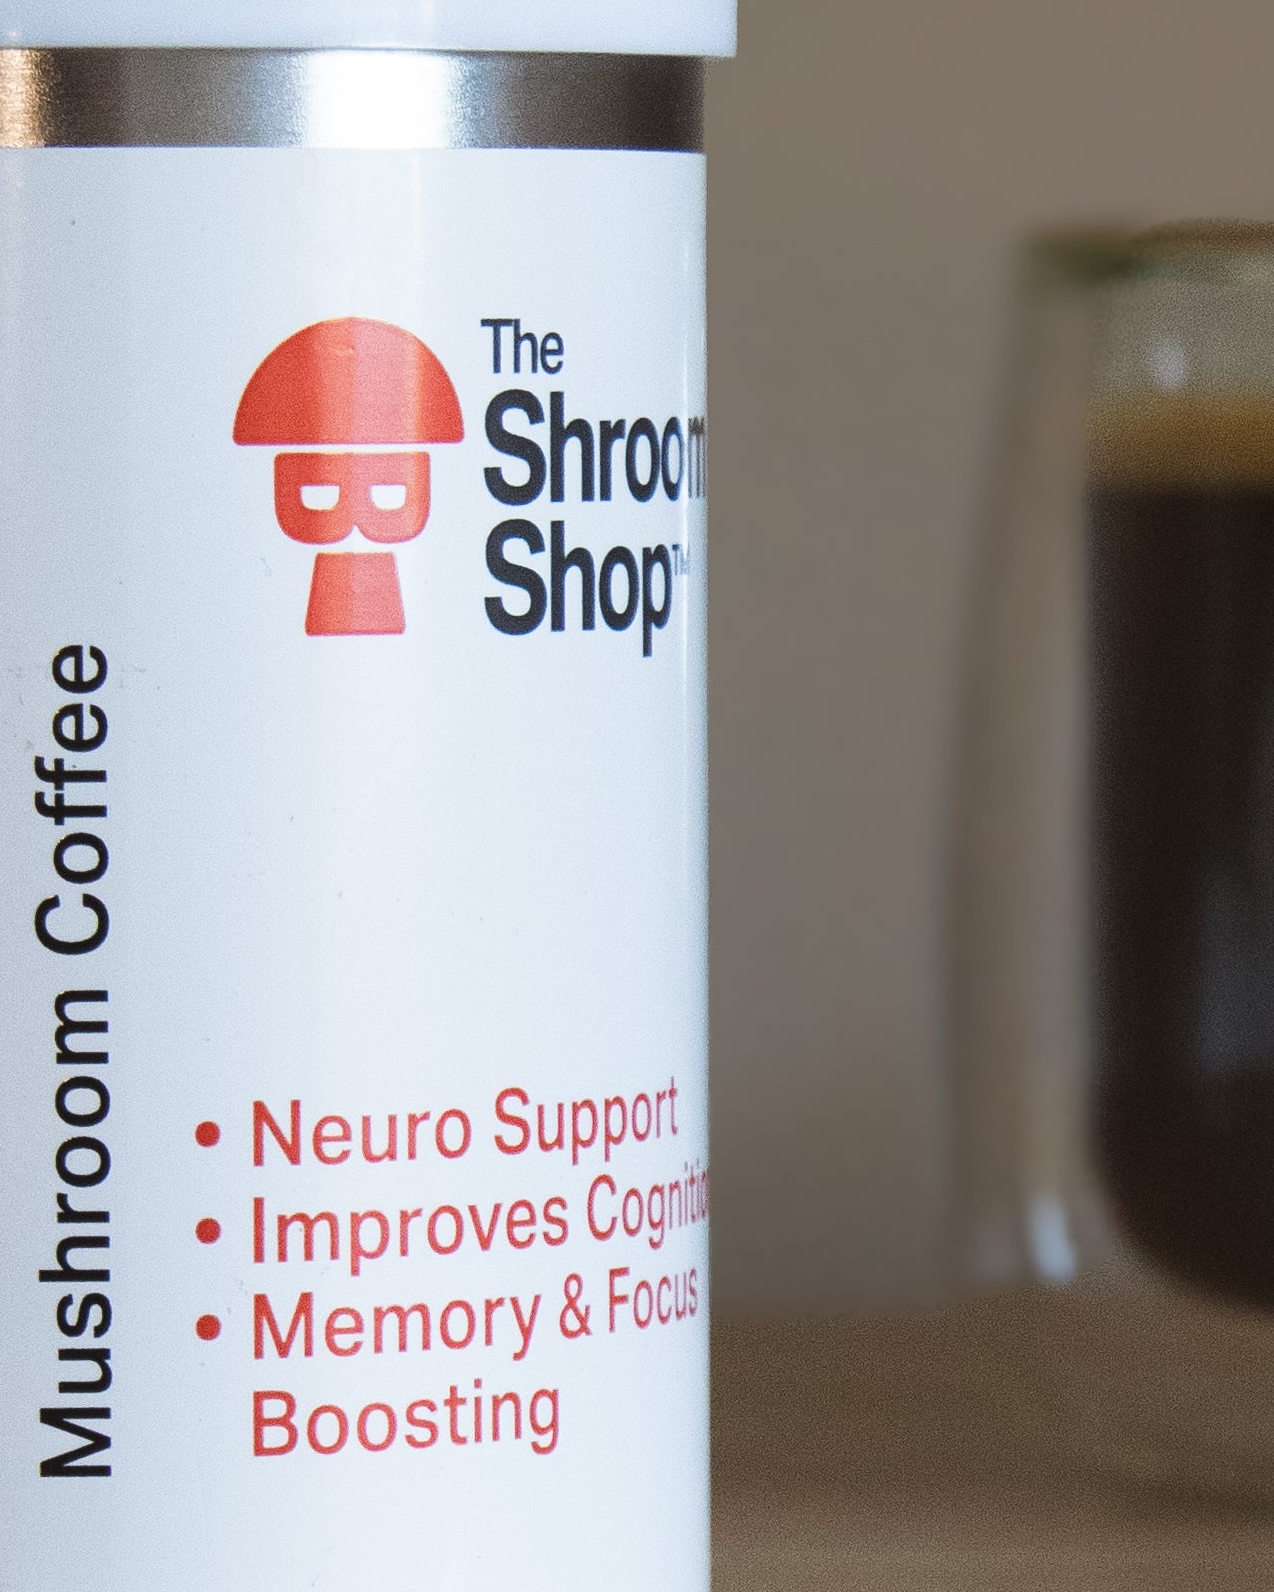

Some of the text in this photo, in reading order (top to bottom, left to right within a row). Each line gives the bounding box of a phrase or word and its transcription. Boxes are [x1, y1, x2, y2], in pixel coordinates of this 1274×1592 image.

[480, 318, 564, 374] The
[483, 388, 707, 506] Shroom
[33, 643, 113, 1478] Mushroom Coffee
[251, 1076, 678, 1168] Neuro Support
[252, 1195, 570, 1277] Improves
[252, 1266, 700, 1362] Memory & Focus
[251, 1377, 560, 1458] Boosting
